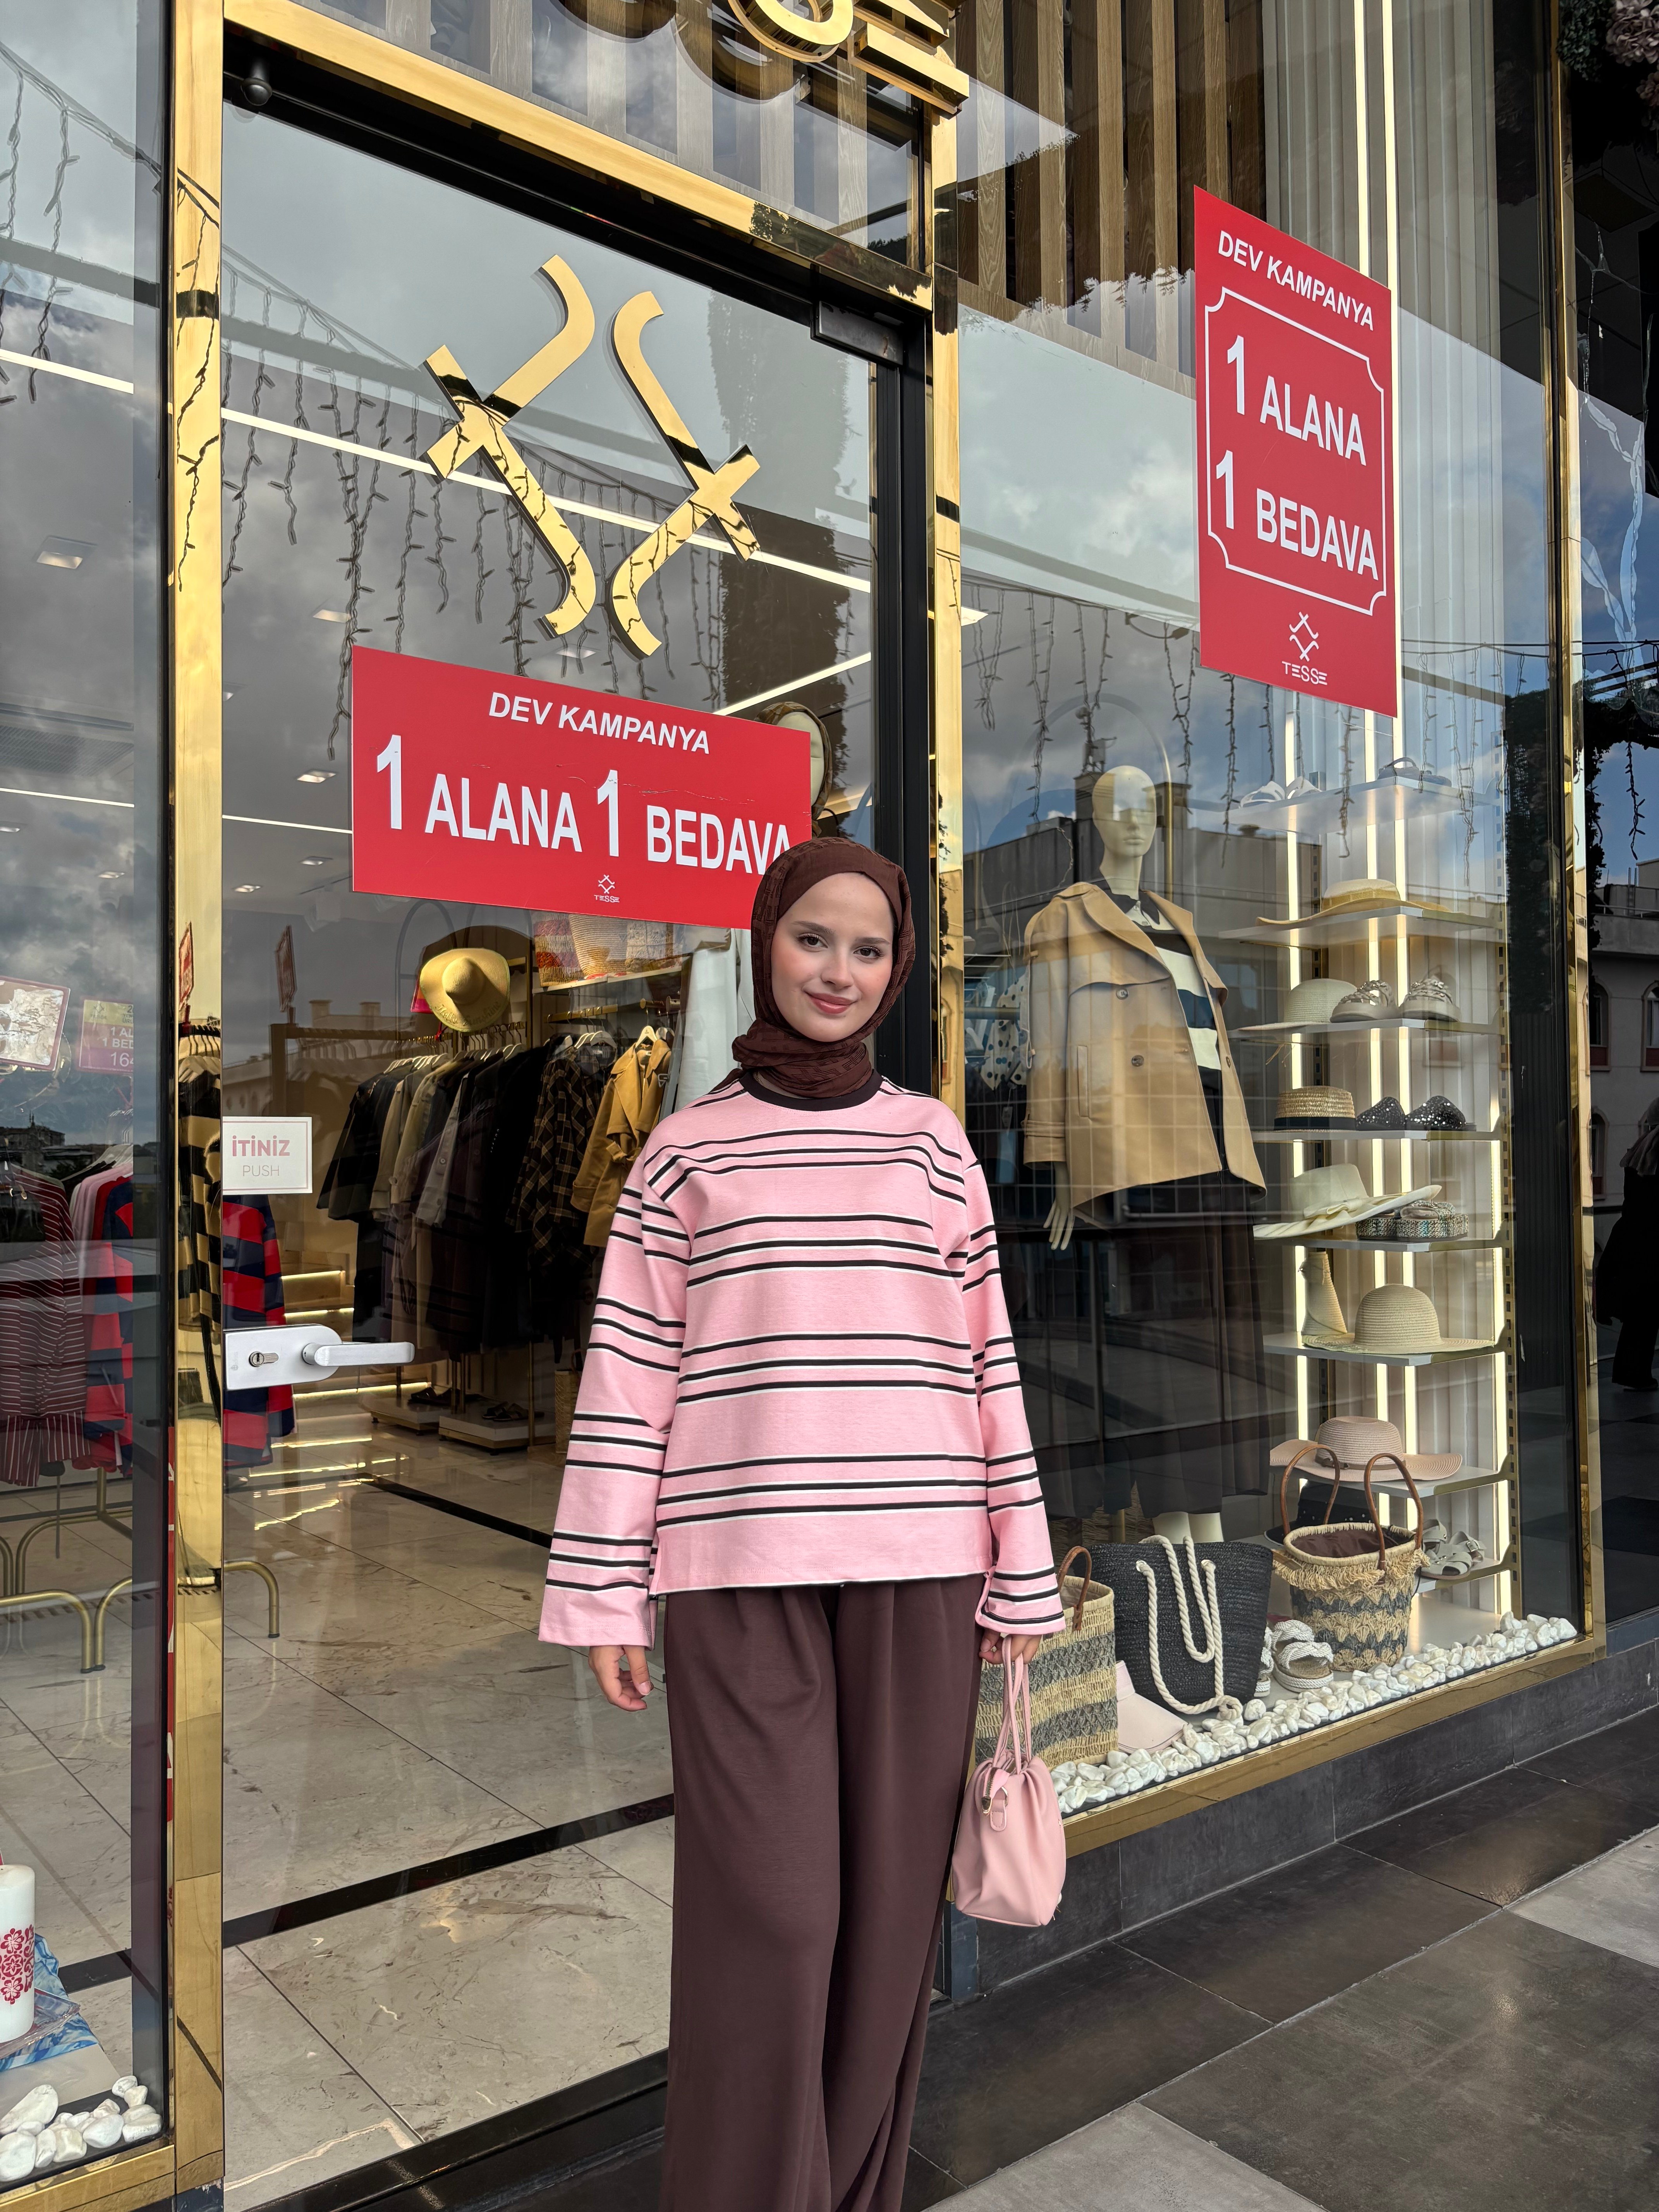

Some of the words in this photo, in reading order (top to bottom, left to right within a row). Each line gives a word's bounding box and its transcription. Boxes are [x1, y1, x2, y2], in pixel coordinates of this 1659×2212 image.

[1218, 230, 1263, 272] DEV
[1267, 256, 1374, 331] KAMPANYA
[1227, 335, 1245, 416] 1
[1260, 375, 1367, 466] ALANA
[1216, 450, 1234, 530] 1
[1256, 488, 1379, 580] BEDAVA
[1281, 661, 1328, 686] TESSE
[489, 691, 553, 725] DEV
[558, 704, 709, 755] KAMPANYA
[377, 734, 402, 830] 1
[424, 773, 583, 853] ALANA
[597, 769, 620, 857] 1
[594, 894, 620, 903] TESSE
[243, 1165, 279, 1176] PUSH
